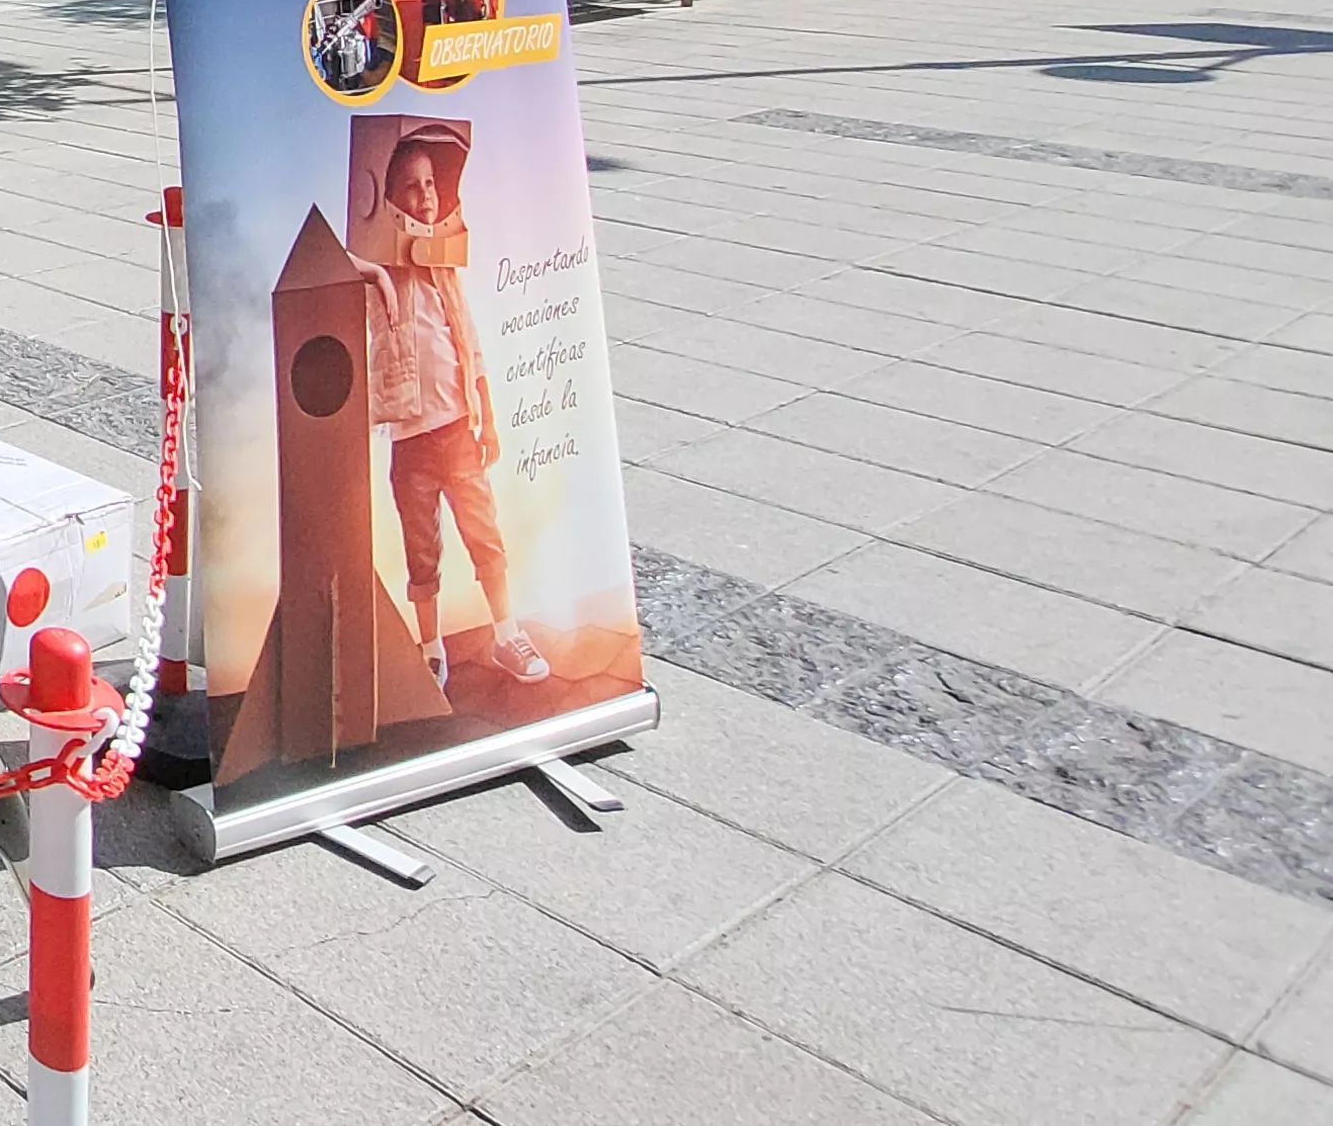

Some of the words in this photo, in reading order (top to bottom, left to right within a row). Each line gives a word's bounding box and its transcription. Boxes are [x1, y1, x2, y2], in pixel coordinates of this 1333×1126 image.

[429, 21, 555, 68] OBSERVATORIO
[497, 236, 589, 295] Despertando
[501, 295, 580, 336] vocaciones
[511, 390, 553, 428] desde
[561, 378, 578, 409] la
[516, 432, 579, 482] infancia.
